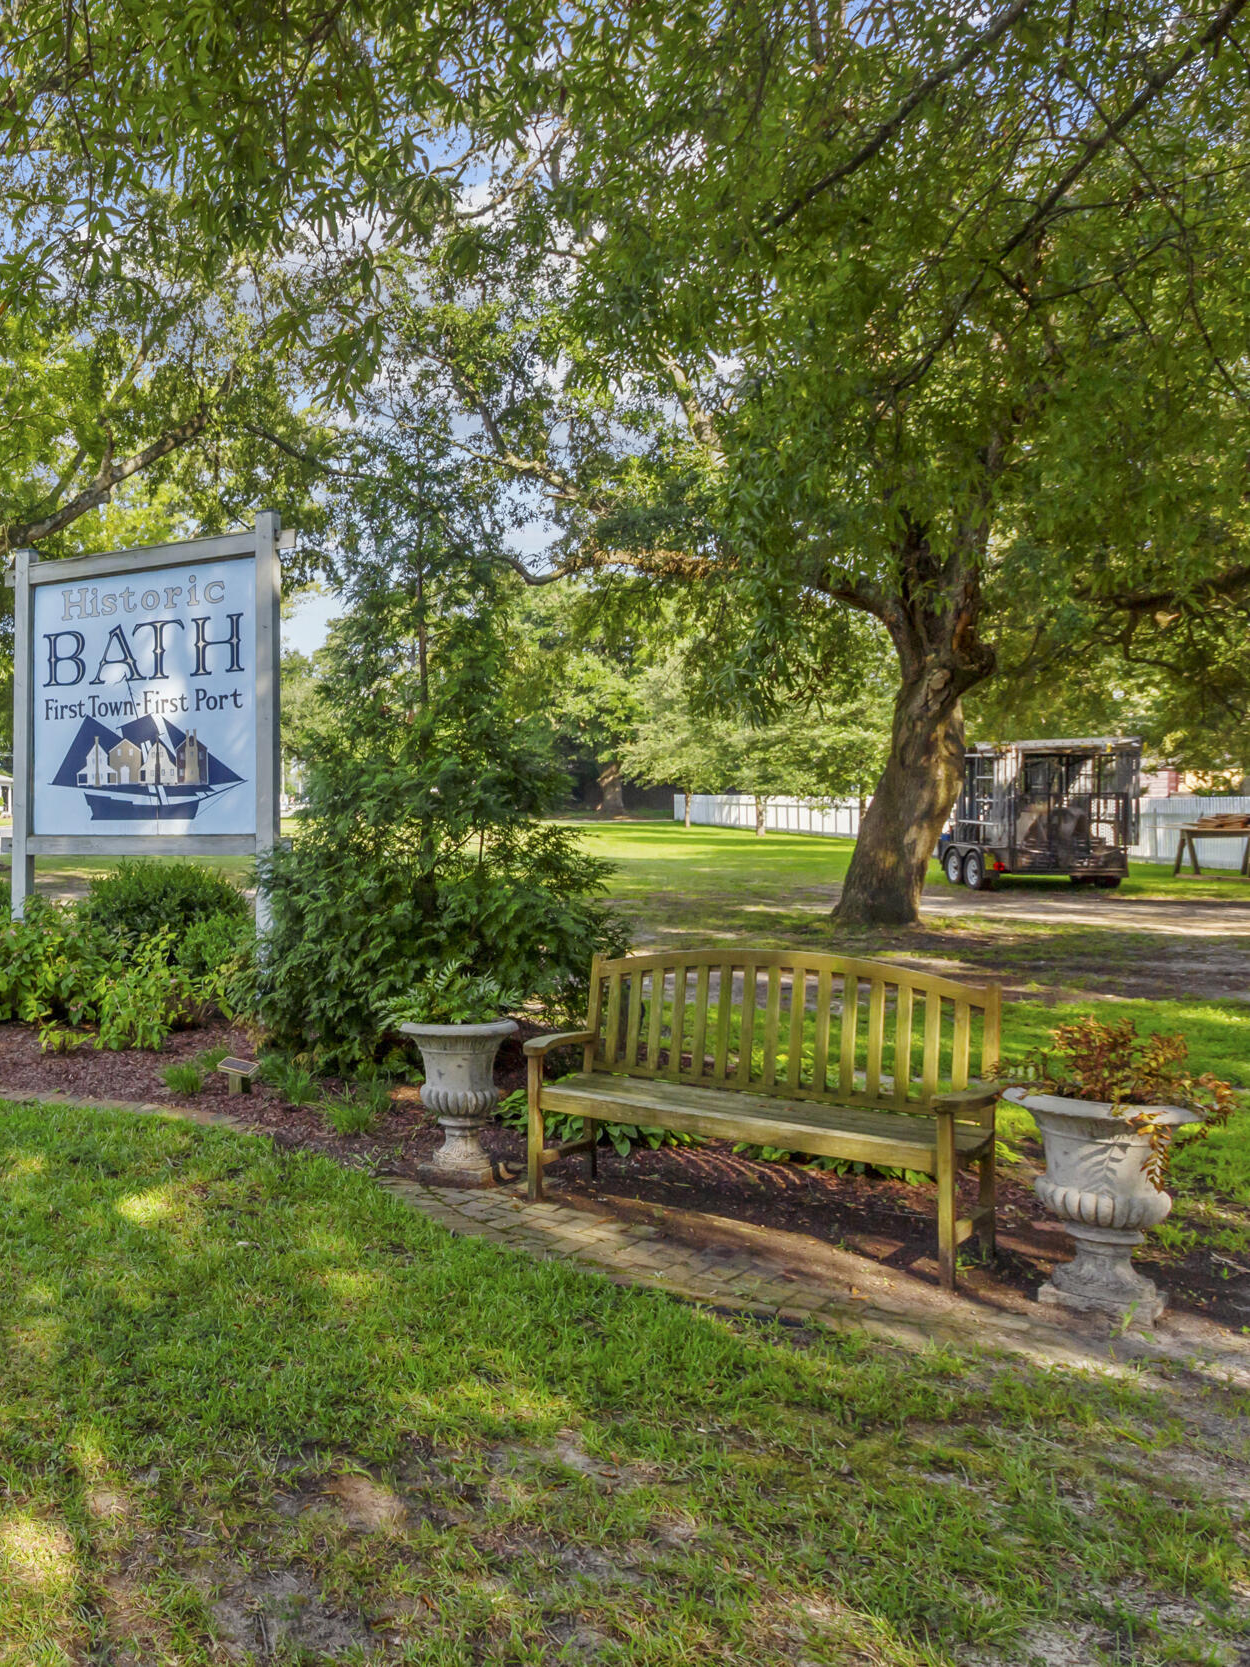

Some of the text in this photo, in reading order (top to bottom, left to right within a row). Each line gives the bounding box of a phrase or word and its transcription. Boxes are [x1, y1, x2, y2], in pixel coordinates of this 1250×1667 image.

[61, 574, 226, 621] Historic
[42, 612, 246, 688] BATH
[44, 698, 87, 721] First
[194, 687, 244, 712] Port
